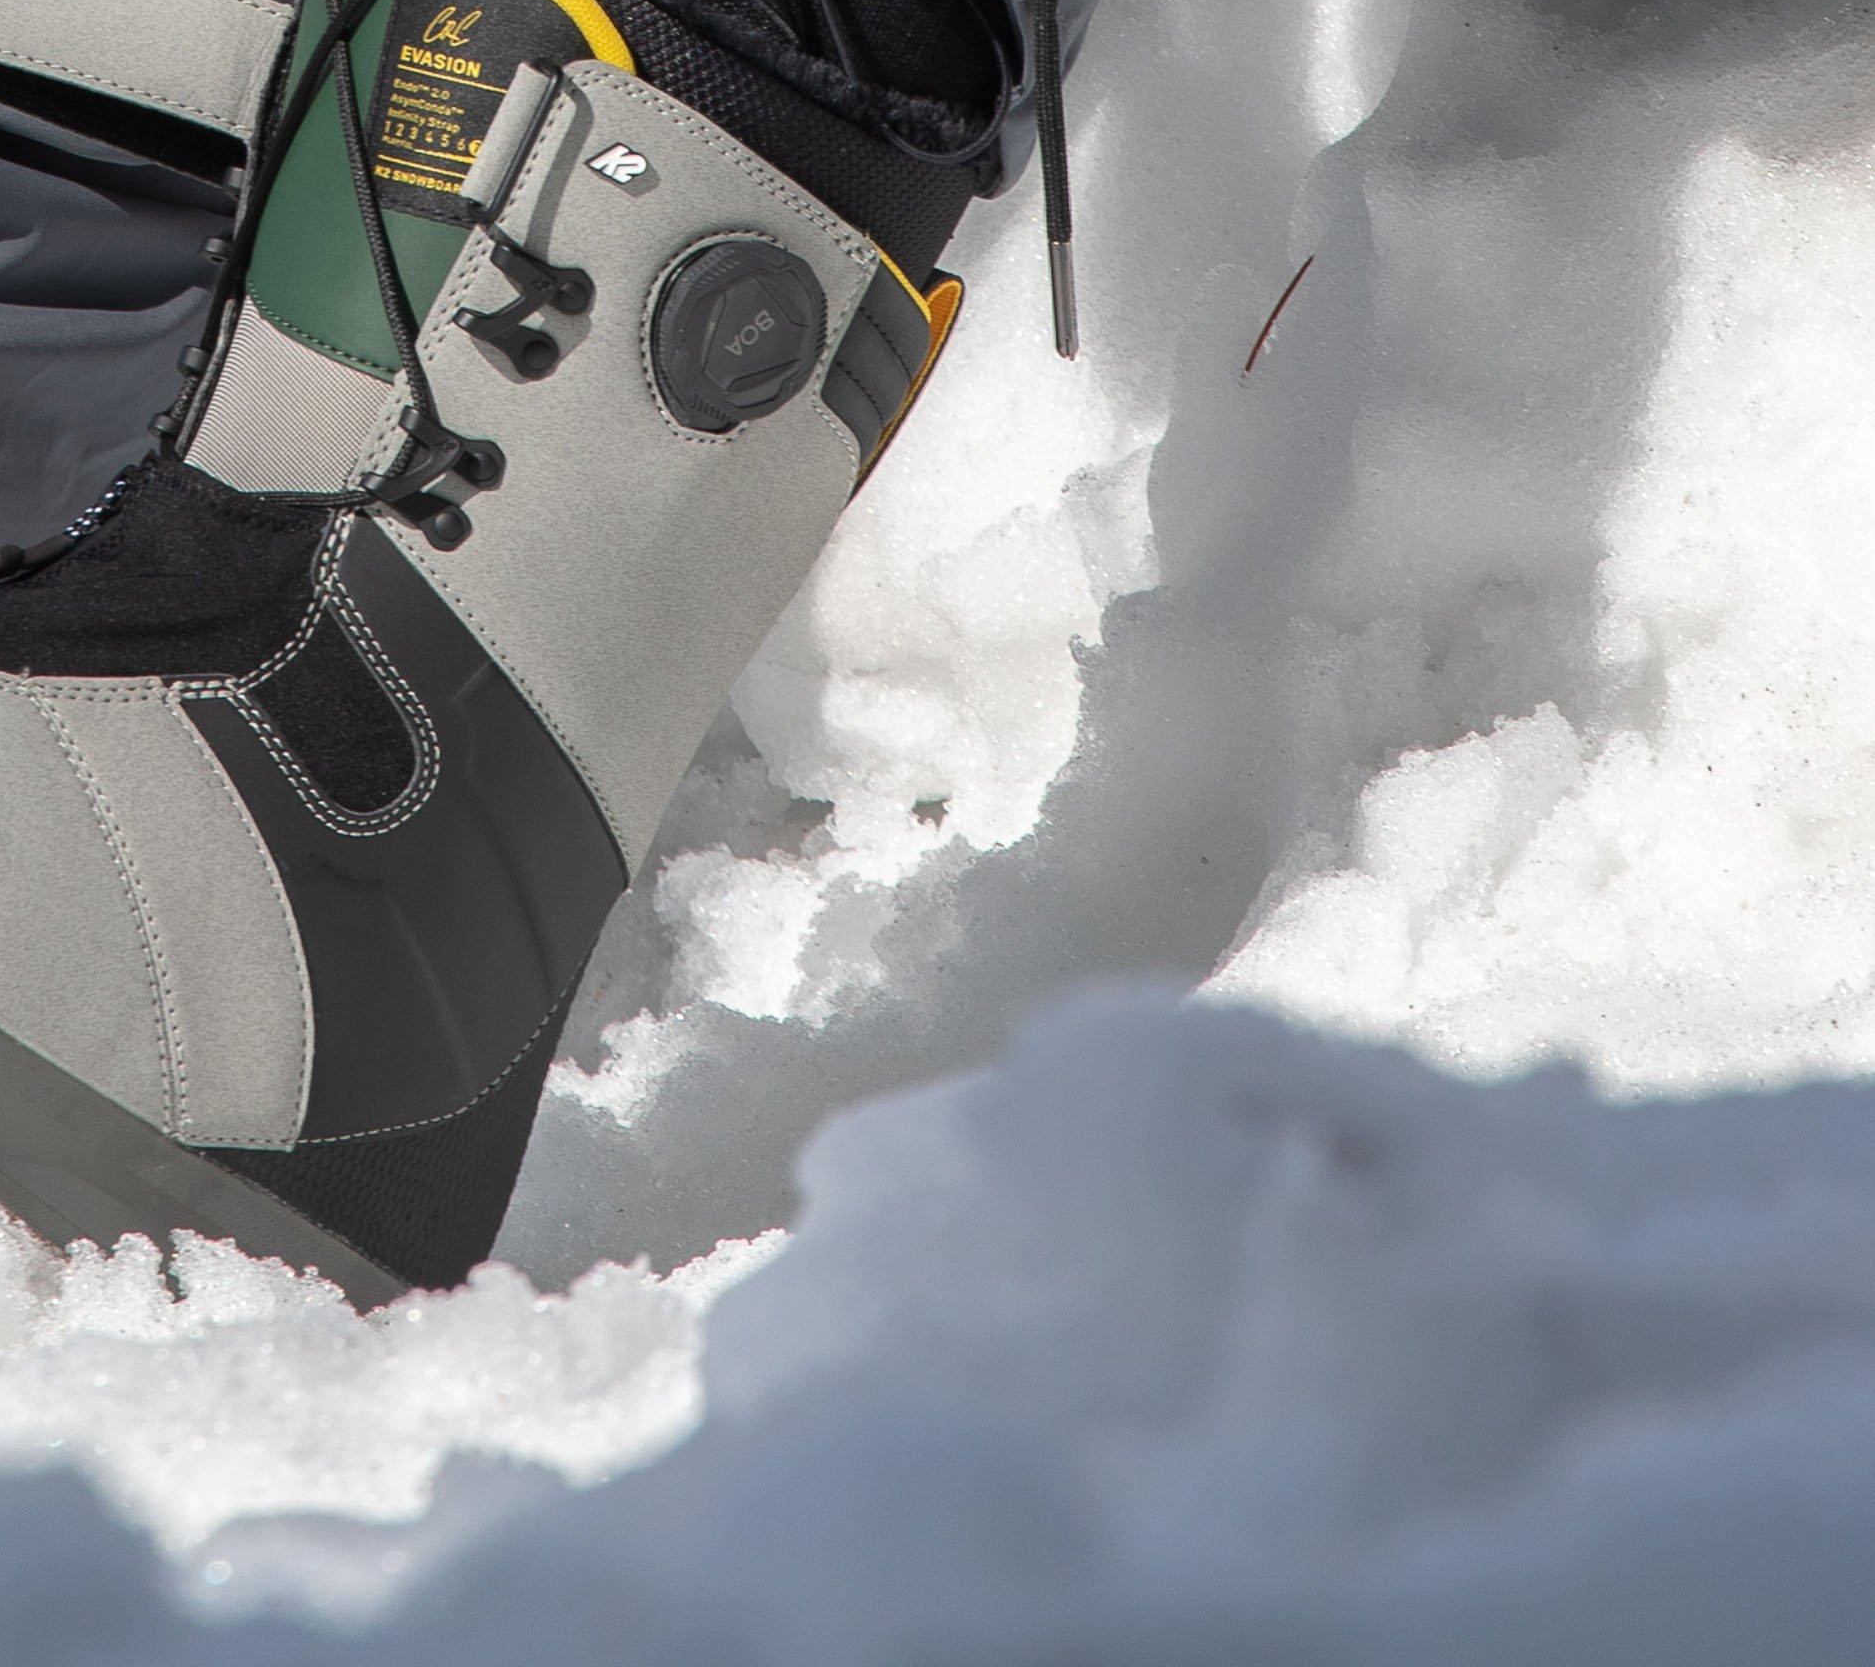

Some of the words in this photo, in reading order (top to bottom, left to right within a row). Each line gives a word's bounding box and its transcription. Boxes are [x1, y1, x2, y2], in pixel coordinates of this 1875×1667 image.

[399, 45, 482, 79] EVASION
[384, 120, 393, 133] 1
[395, 123, 405, 137] 2
[409, 126, 419, 140] 3
[424, 130, 435, 143] 4
[440, 133, 451, 148] 5
[456, 137, 466, 152] 6
[427, 116, 462, 134] Strap
[374, 165, 391, 179] K2
[392, 169, 462, 195] SNOWBOAR
[587, 143, 647, 185] K2
[723, 309, 776, 357] BOA
